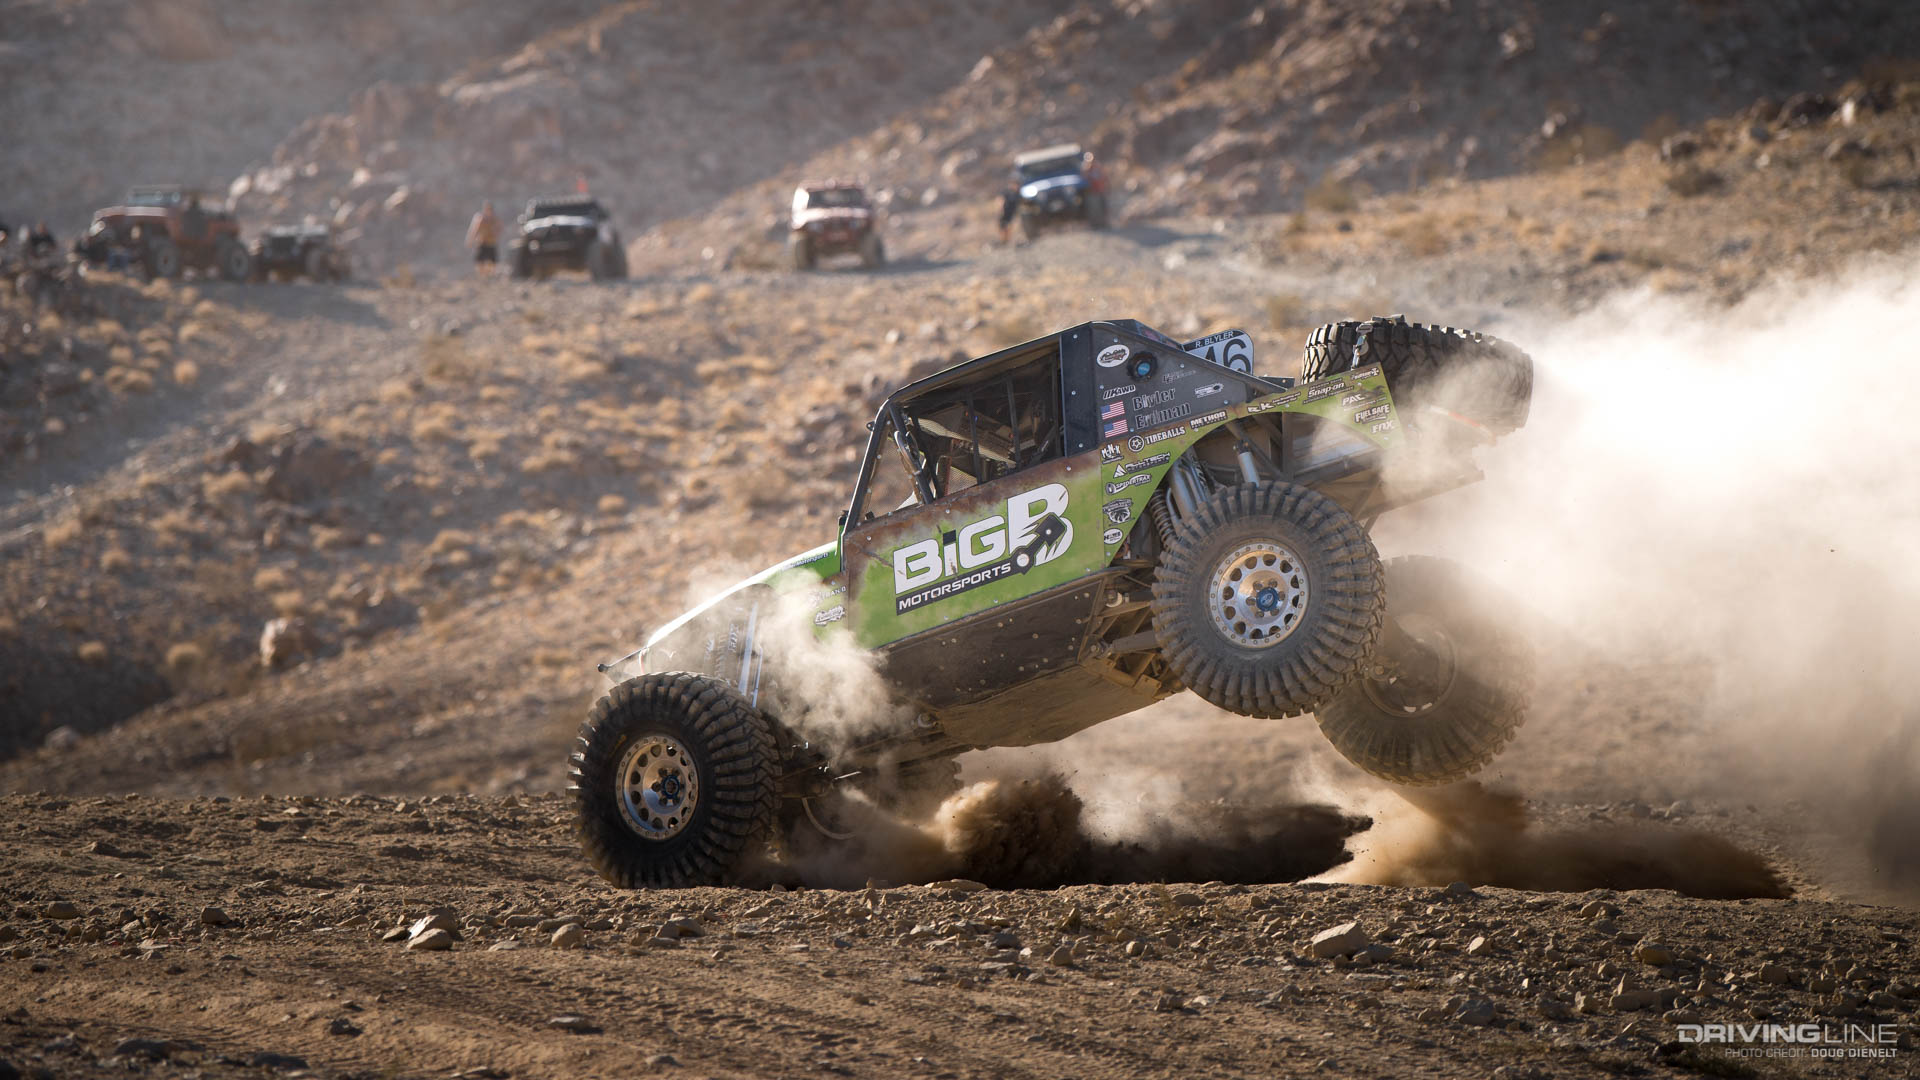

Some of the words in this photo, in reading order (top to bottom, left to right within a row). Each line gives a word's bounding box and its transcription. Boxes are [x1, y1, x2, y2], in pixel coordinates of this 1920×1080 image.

[1205, 331, 1235, 345] BLYLER
[1132, 388, 1176, 411] Blyler
[1308, 382, 1345, 398] Snap-on
[1135, 402, 1192, 429] Erdman
[1190, 411, 1226, 426] METHOD
[1355, 409, 1371, 422] FUEL
[1371, 403, 1390, 416] SAFE
[1145, 426, 1186, 445] TIREBALLS
[898, 562, 1012, 611] MOTORSPORTS
